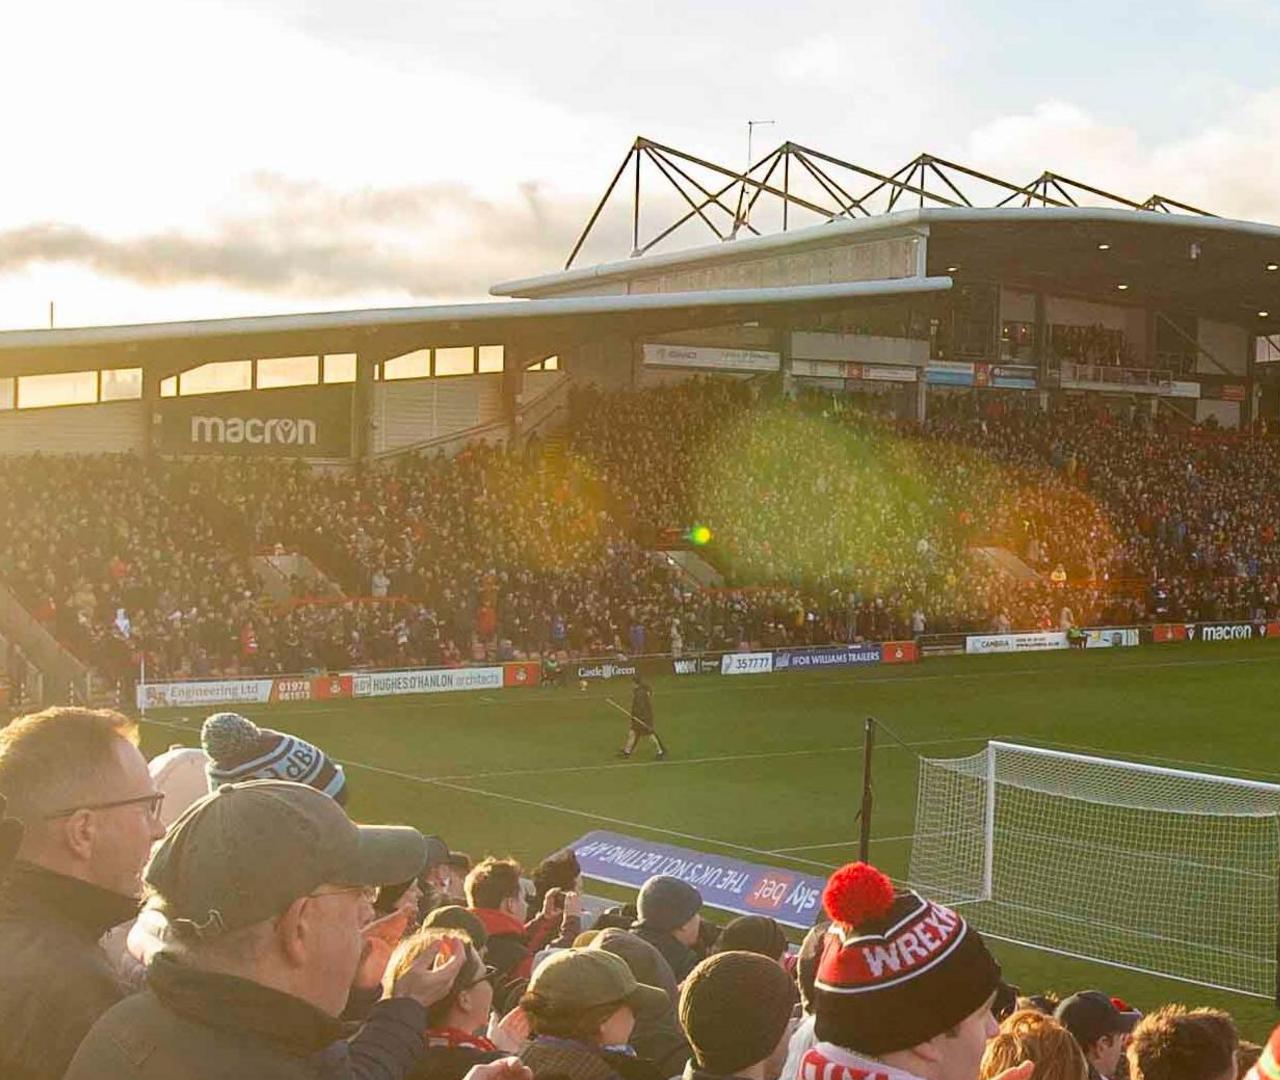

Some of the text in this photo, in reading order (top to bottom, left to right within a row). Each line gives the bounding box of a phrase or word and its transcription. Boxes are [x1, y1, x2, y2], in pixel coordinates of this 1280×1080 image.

[190, 415, 316, 444] macron
[1203, 624, 1252, 641] macron
[811, 651, 848, 665] WILLIAMS
[848, 650, 880, 662] TRAILERS
[454, 672, 499, 687] architects
[578, 665, 635, 677] Castle Green
[170, 685, 239, 699] Engineering
[241, 683, 258, 694] Ltd
[720, 873, 749, 894] THE
[753, 878, 787, 906] bet
[785, 879, 820, 914] sky
